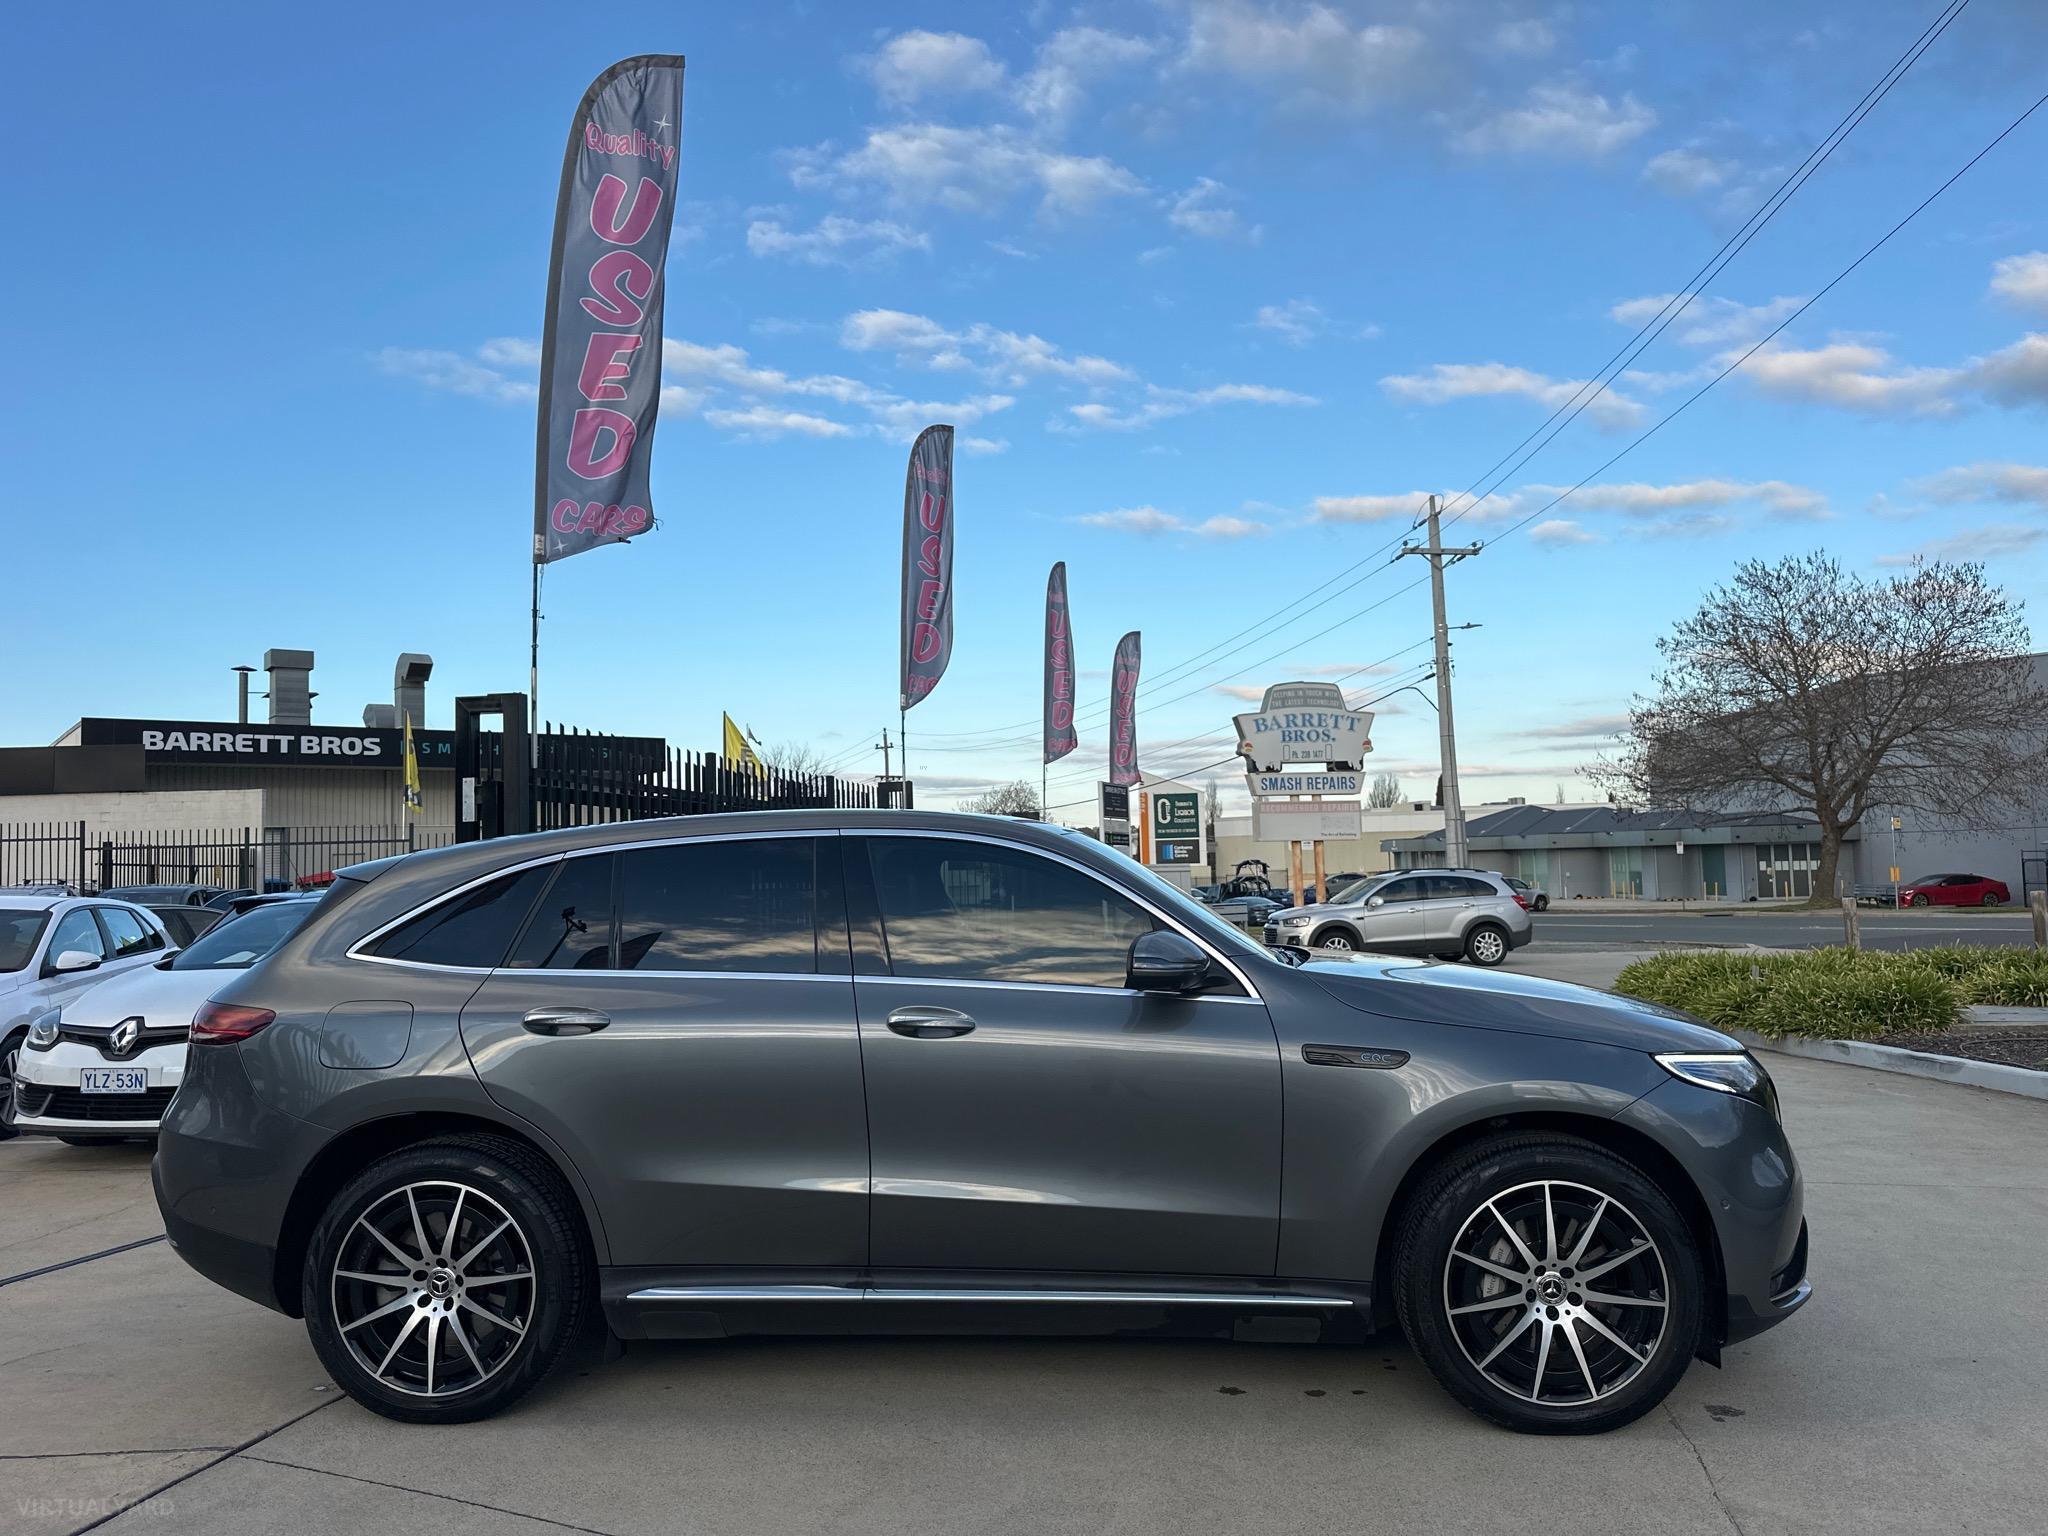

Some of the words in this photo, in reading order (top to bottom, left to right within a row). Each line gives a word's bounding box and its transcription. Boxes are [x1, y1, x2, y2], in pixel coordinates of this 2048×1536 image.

[585, 121, 675, 170] Quality
[567, 173, 664, 481] USED
[551, 498, 648, 536] CARS
[911, 490, 946, 664] USED
[1050, 609, 1073, 731] USED
[1114, 670, 1136, 767] USED
[1253, 713, 1361, 733] BARRETT
[1281, 728, 1336, 743] BROS.
[142, 730, 294, 754] BARRETT
[300, 735, 381, 756] BROS
[1261, 777, 1302, 791] SMASH
[1307, 776, 1356, 790] REPAIRS
[1360, 1052, 1391, 1063] EQC
